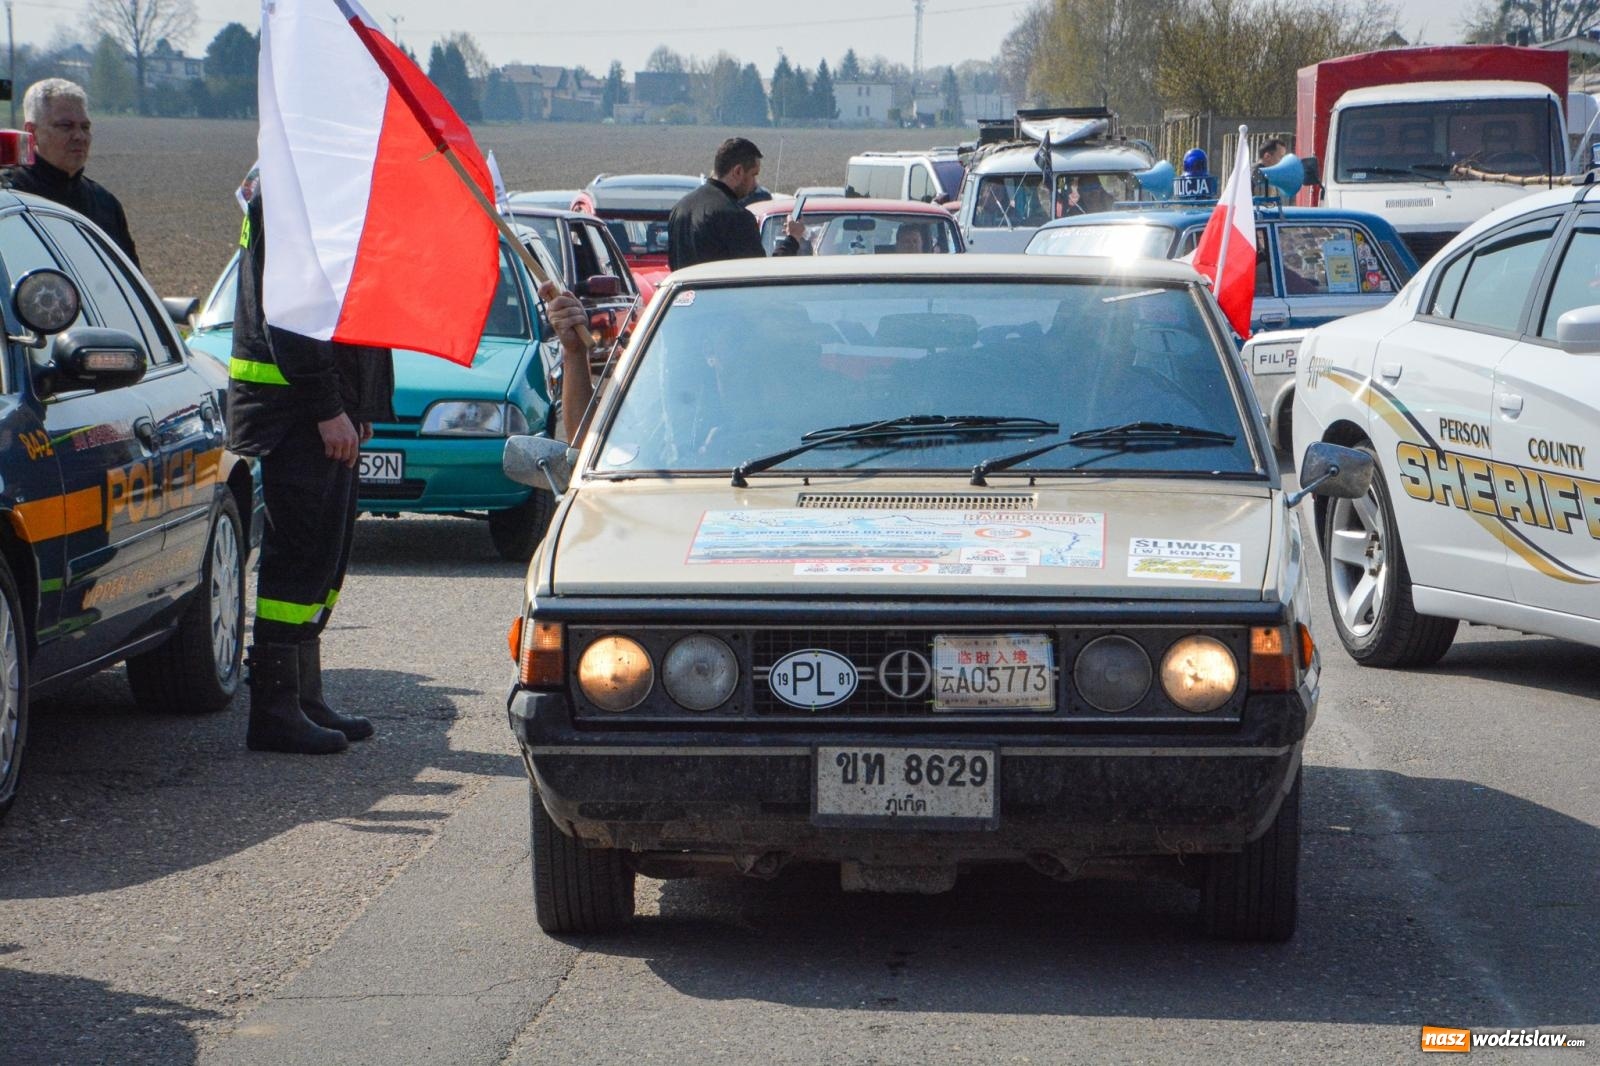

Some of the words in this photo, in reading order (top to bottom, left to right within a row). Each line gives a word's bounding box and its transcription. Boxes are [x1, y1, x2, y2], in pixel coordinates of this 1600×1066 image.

[1439, 417, 1491, 449] PERSON
[1527, 437, 1586, 470] COUNTY
[106, 448, 194, 533] POLICE
[957, 650, 1029, 664] 临时入境
[776, 672, 789, 687] 19
[791, 661, 835, 696] PL
[838, 671, 851, 686] 81
[905, 753, 989, 787] 8629
